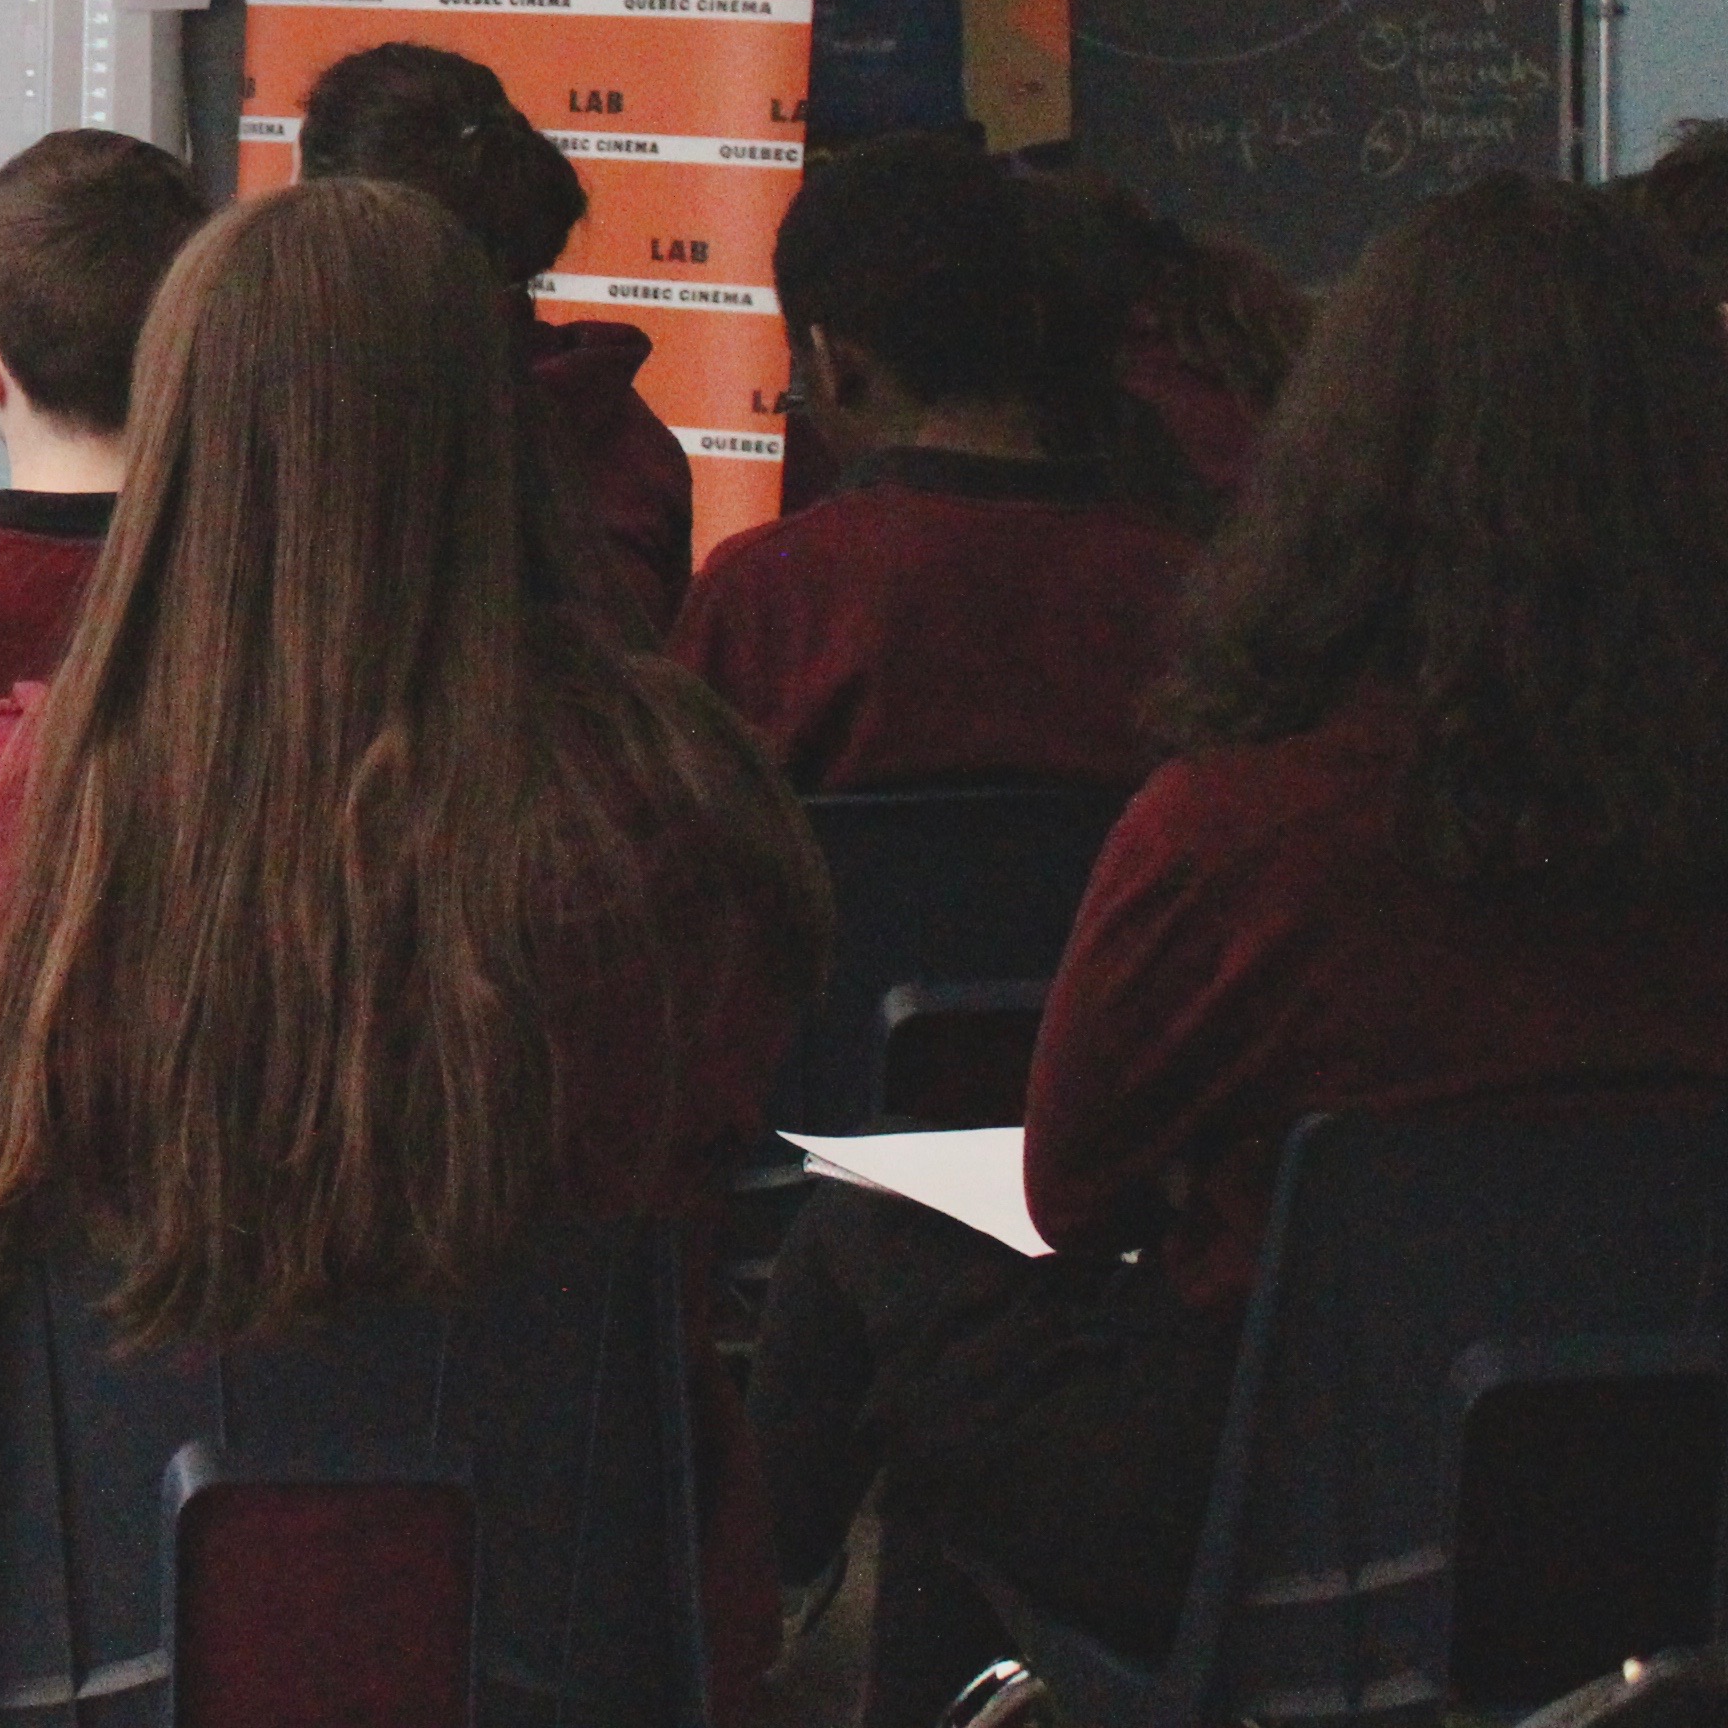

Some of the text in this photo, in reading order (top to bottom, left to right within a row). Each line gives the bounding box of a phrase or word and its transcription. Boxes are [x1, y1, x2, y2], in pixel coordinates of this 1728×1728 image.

[568, 88, 808, 122] LAB LA
[650, 237, 708, 264] LAB
